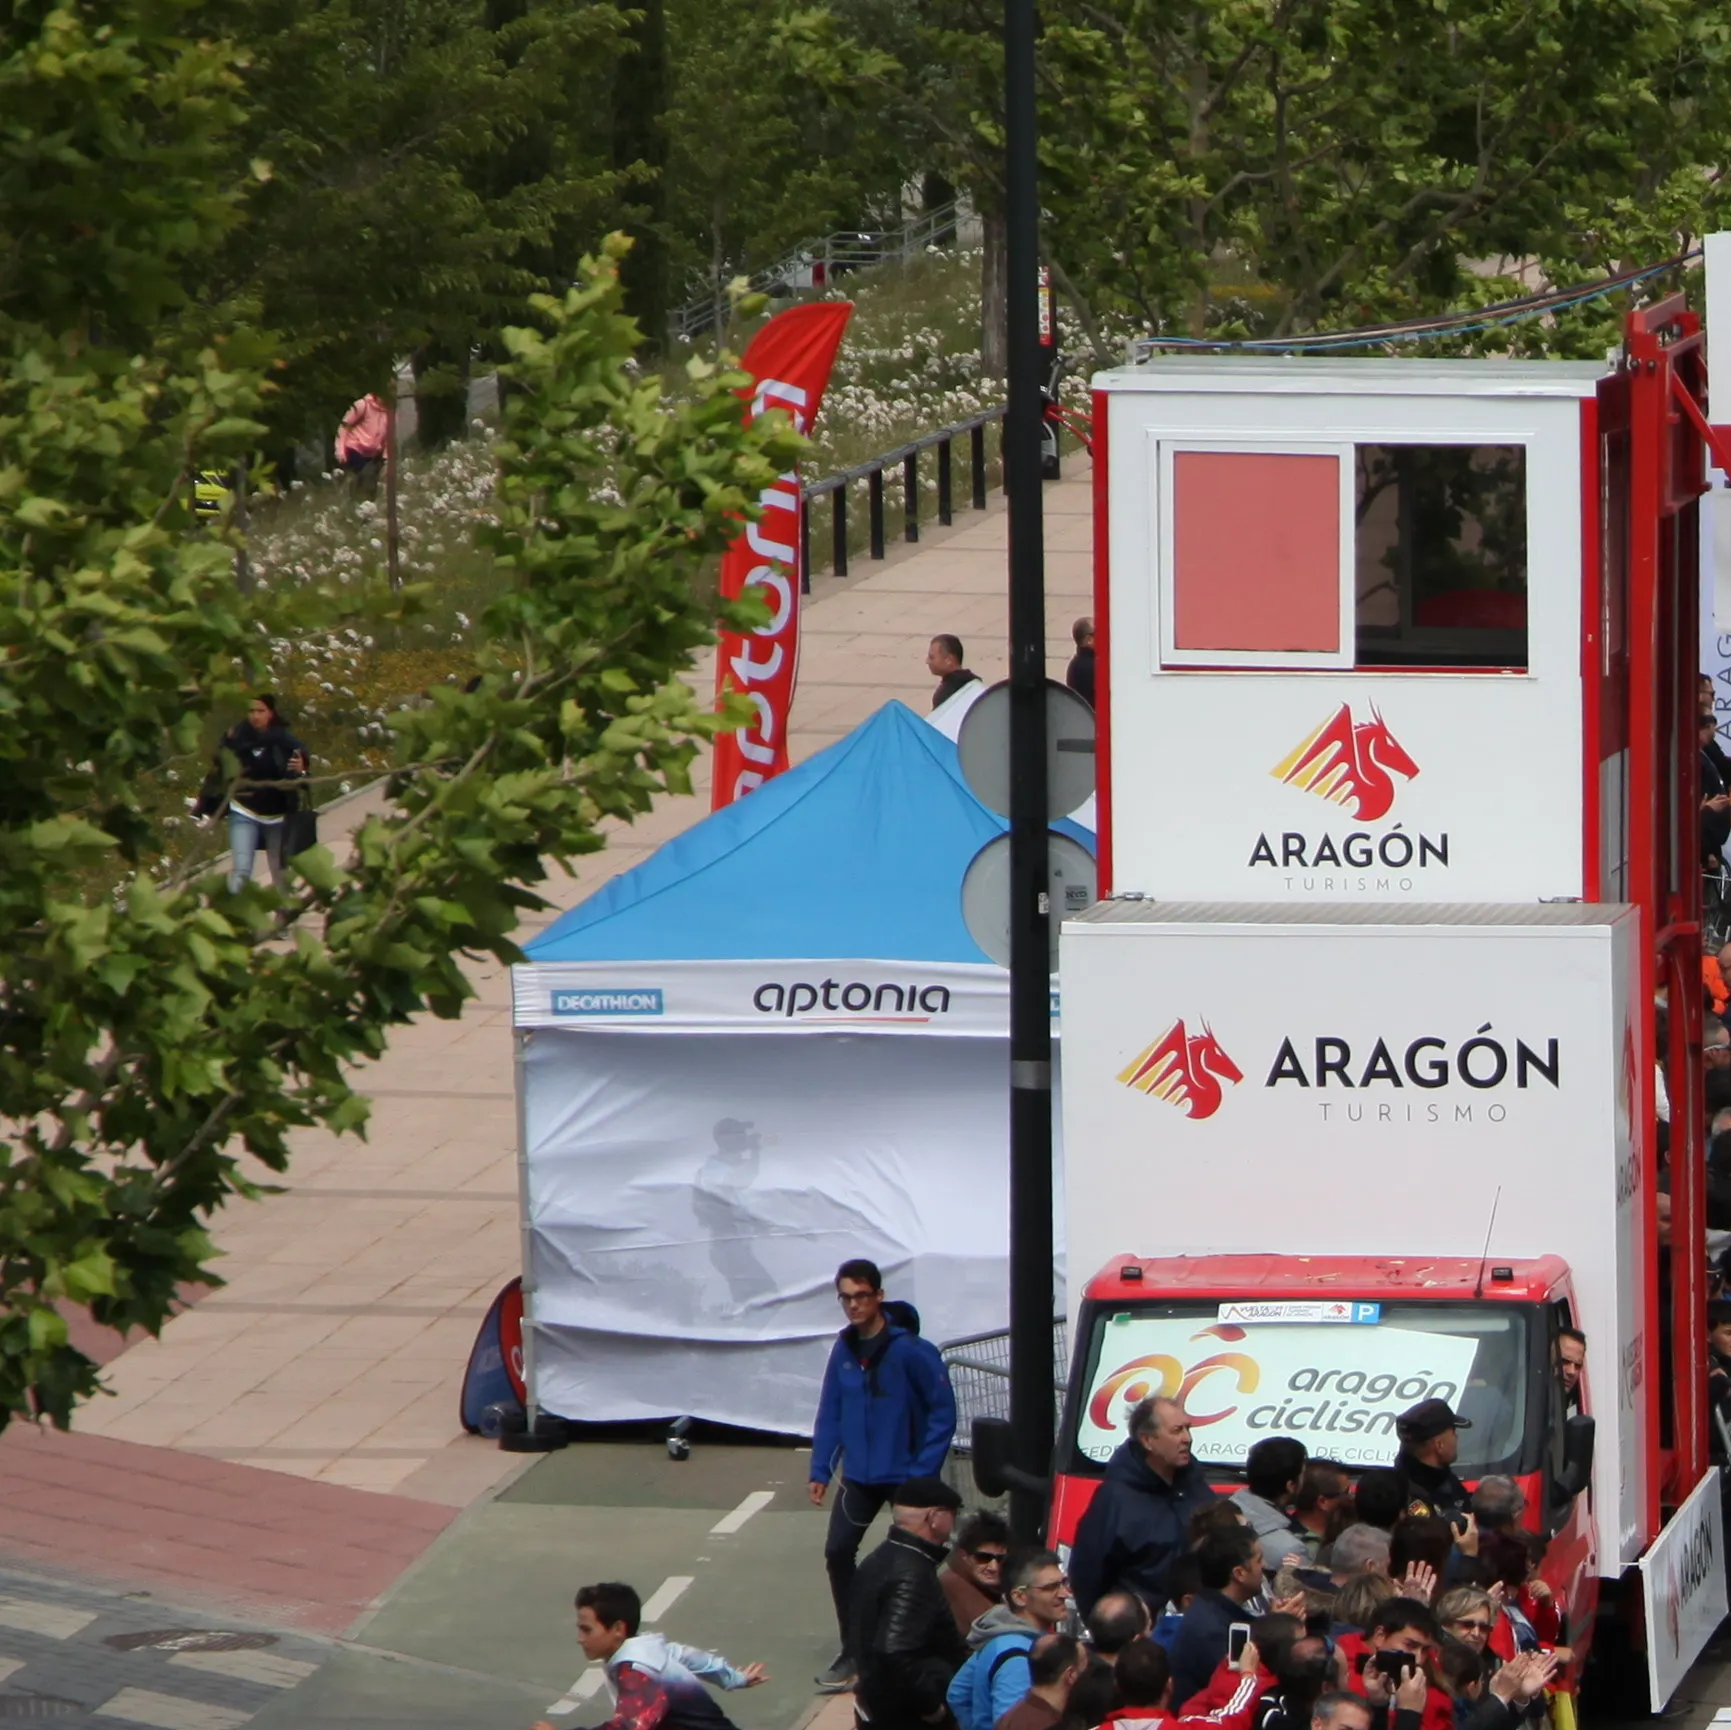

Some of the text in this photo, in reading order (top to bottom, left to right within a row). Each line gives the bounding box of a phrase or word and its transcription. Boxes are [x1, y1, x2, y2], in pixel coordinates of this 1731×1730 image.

[1248, 822, 1450, 868] ARAGÓN
[1283, 876, 1413, 892] TURISMO
[558, 995, 657, 1011] DECATHLON
[754, 978, 951, 1017] aptonia
[1266, 1021, 1561, 1089] ARAGÓN
[1319, 1102, 1507, 1123] TURISMO
[1357, 1305, 1374, 1321] P
[1246, 1397, 1401, 1434] ciclism
[1316, 1445, 1340, 1459] DE
